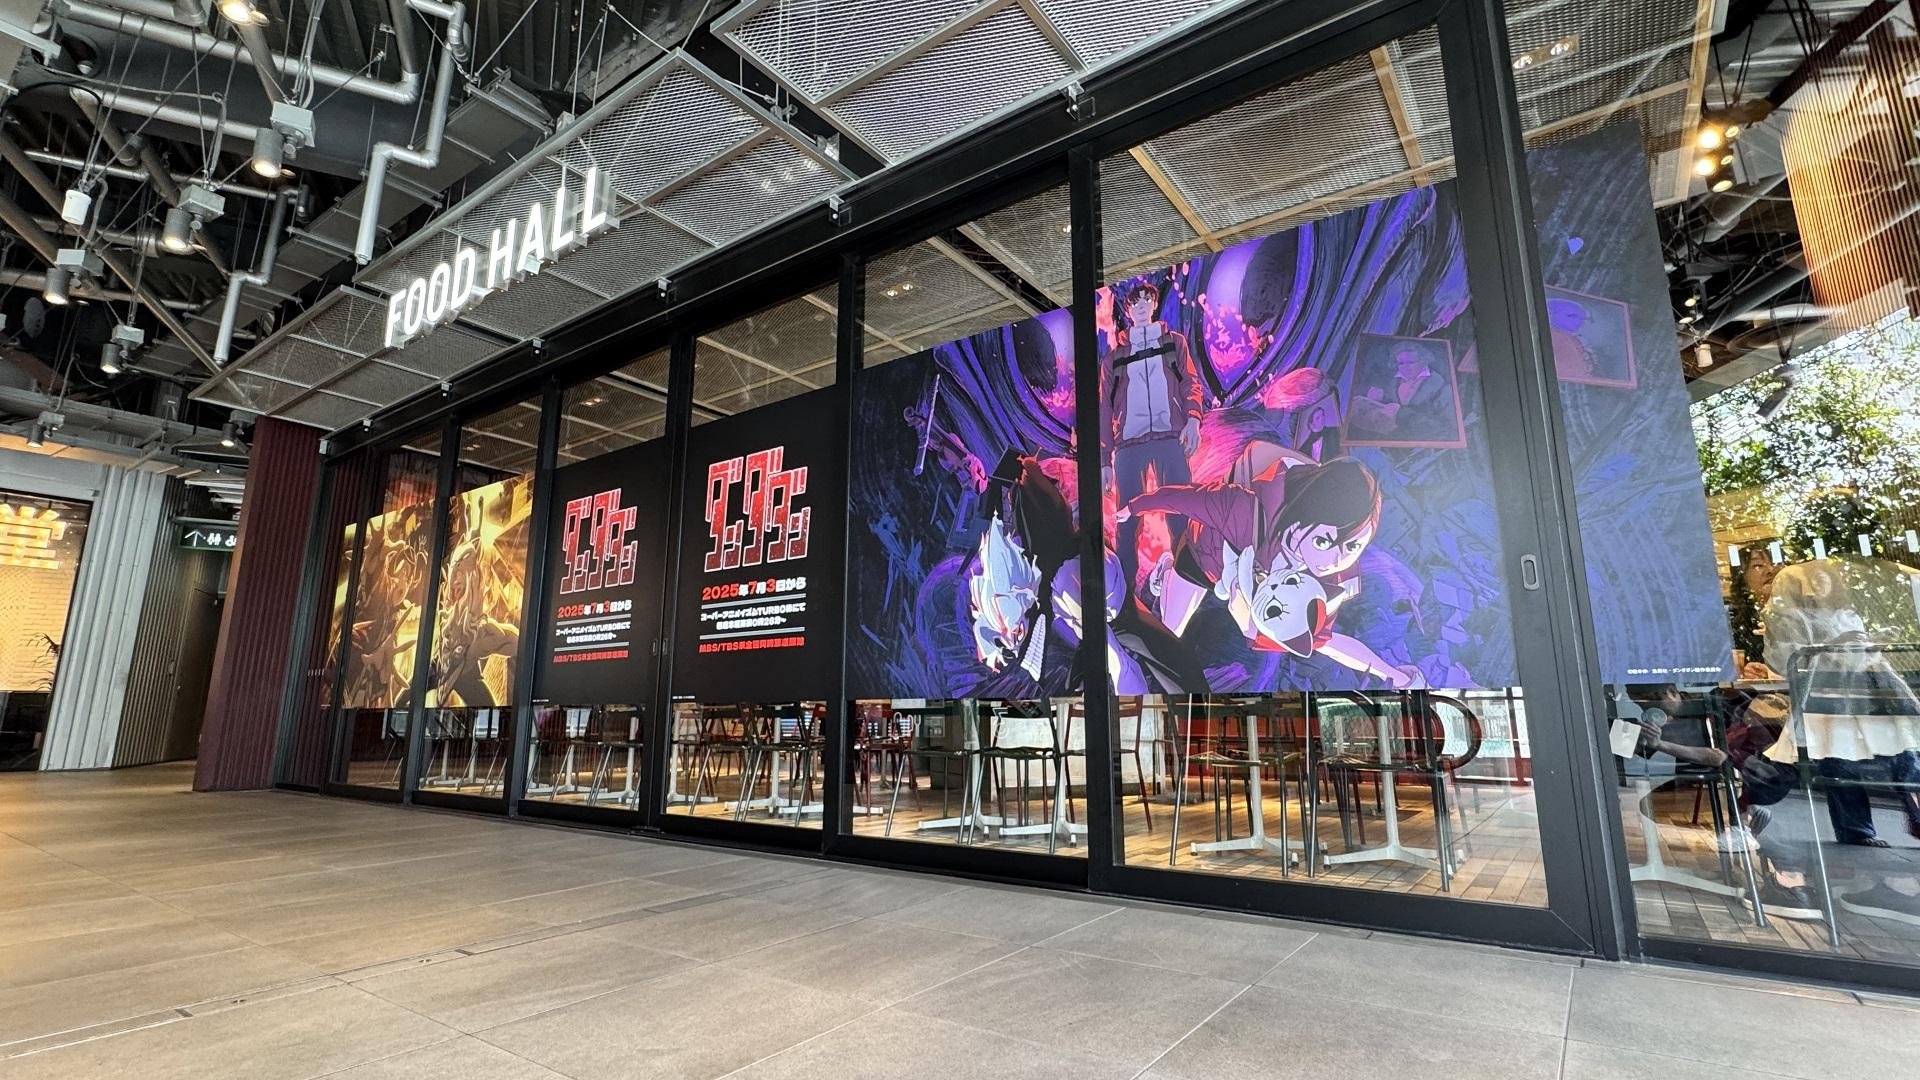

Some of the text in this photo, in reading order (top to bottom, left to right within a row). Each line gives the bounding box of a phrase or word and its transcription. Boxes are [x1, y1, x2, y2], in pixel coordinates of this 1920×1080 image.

[385, 166, 607, 348] FOOD HALL
[702, 577, 807, 601] 2025年7月3日から
